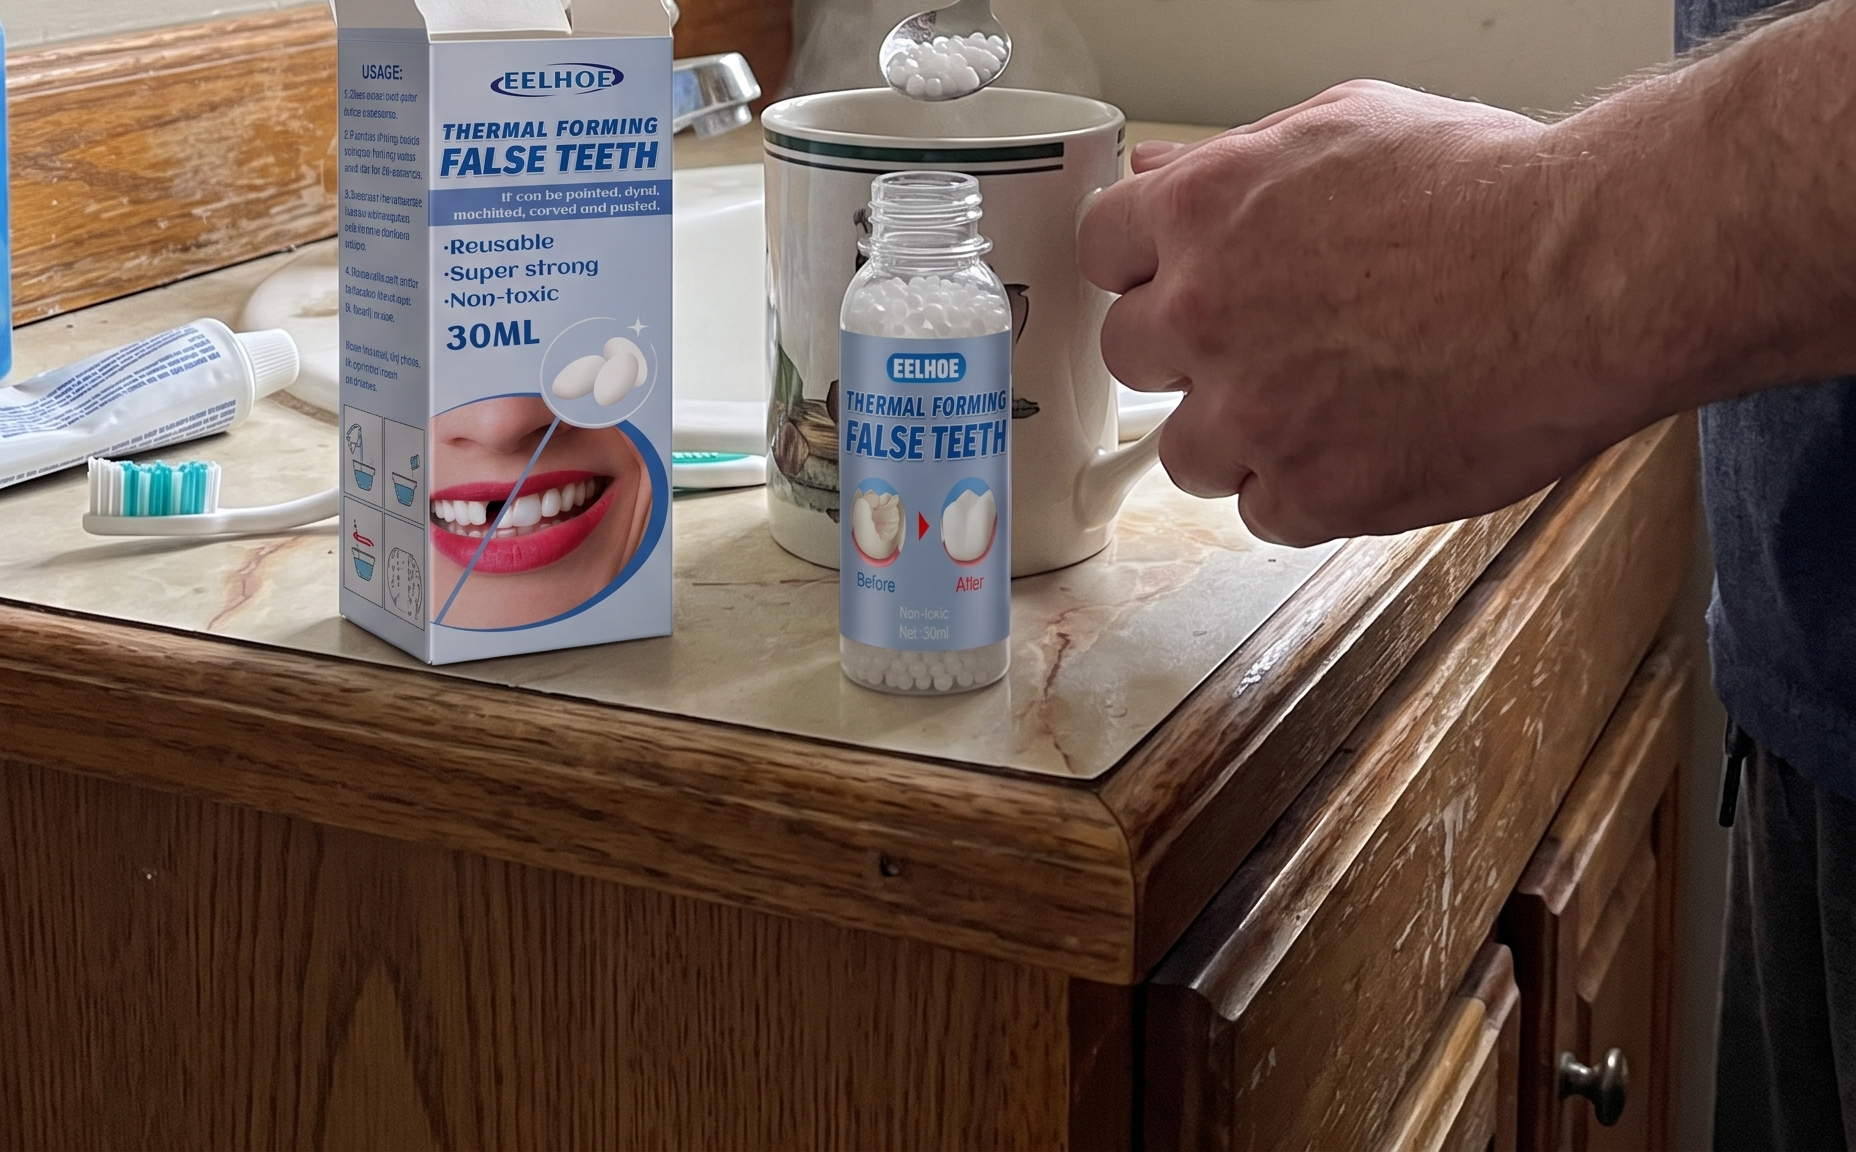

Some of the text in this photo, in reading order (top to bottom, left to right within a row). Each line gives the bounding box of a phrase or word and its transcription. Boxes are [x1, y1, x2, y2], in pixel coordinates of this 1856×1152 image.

[362, 64, 403, 80] USAGE:
[504, 70, 613, 90] EELHOE
[442, 121, 548, 141] THERMAL
[556, 117, 659, 138] FORMING
[440, 144, 548, 177] FALSE
[555, 141, 659, 173] TEETH
[545, 189, 563, 201] be
[580, 202, 607, 214] and
[450, 259, 599, 285] Super strong
[446, 319, 541, 351] 30ML
[893, 358, 960, 379] EELHOE
[846, 389, 1007, 418] THERMAL FORMING
[845, 418, 1008, 460] FALSE TEETH
[857, 571, 896, 593] Before
